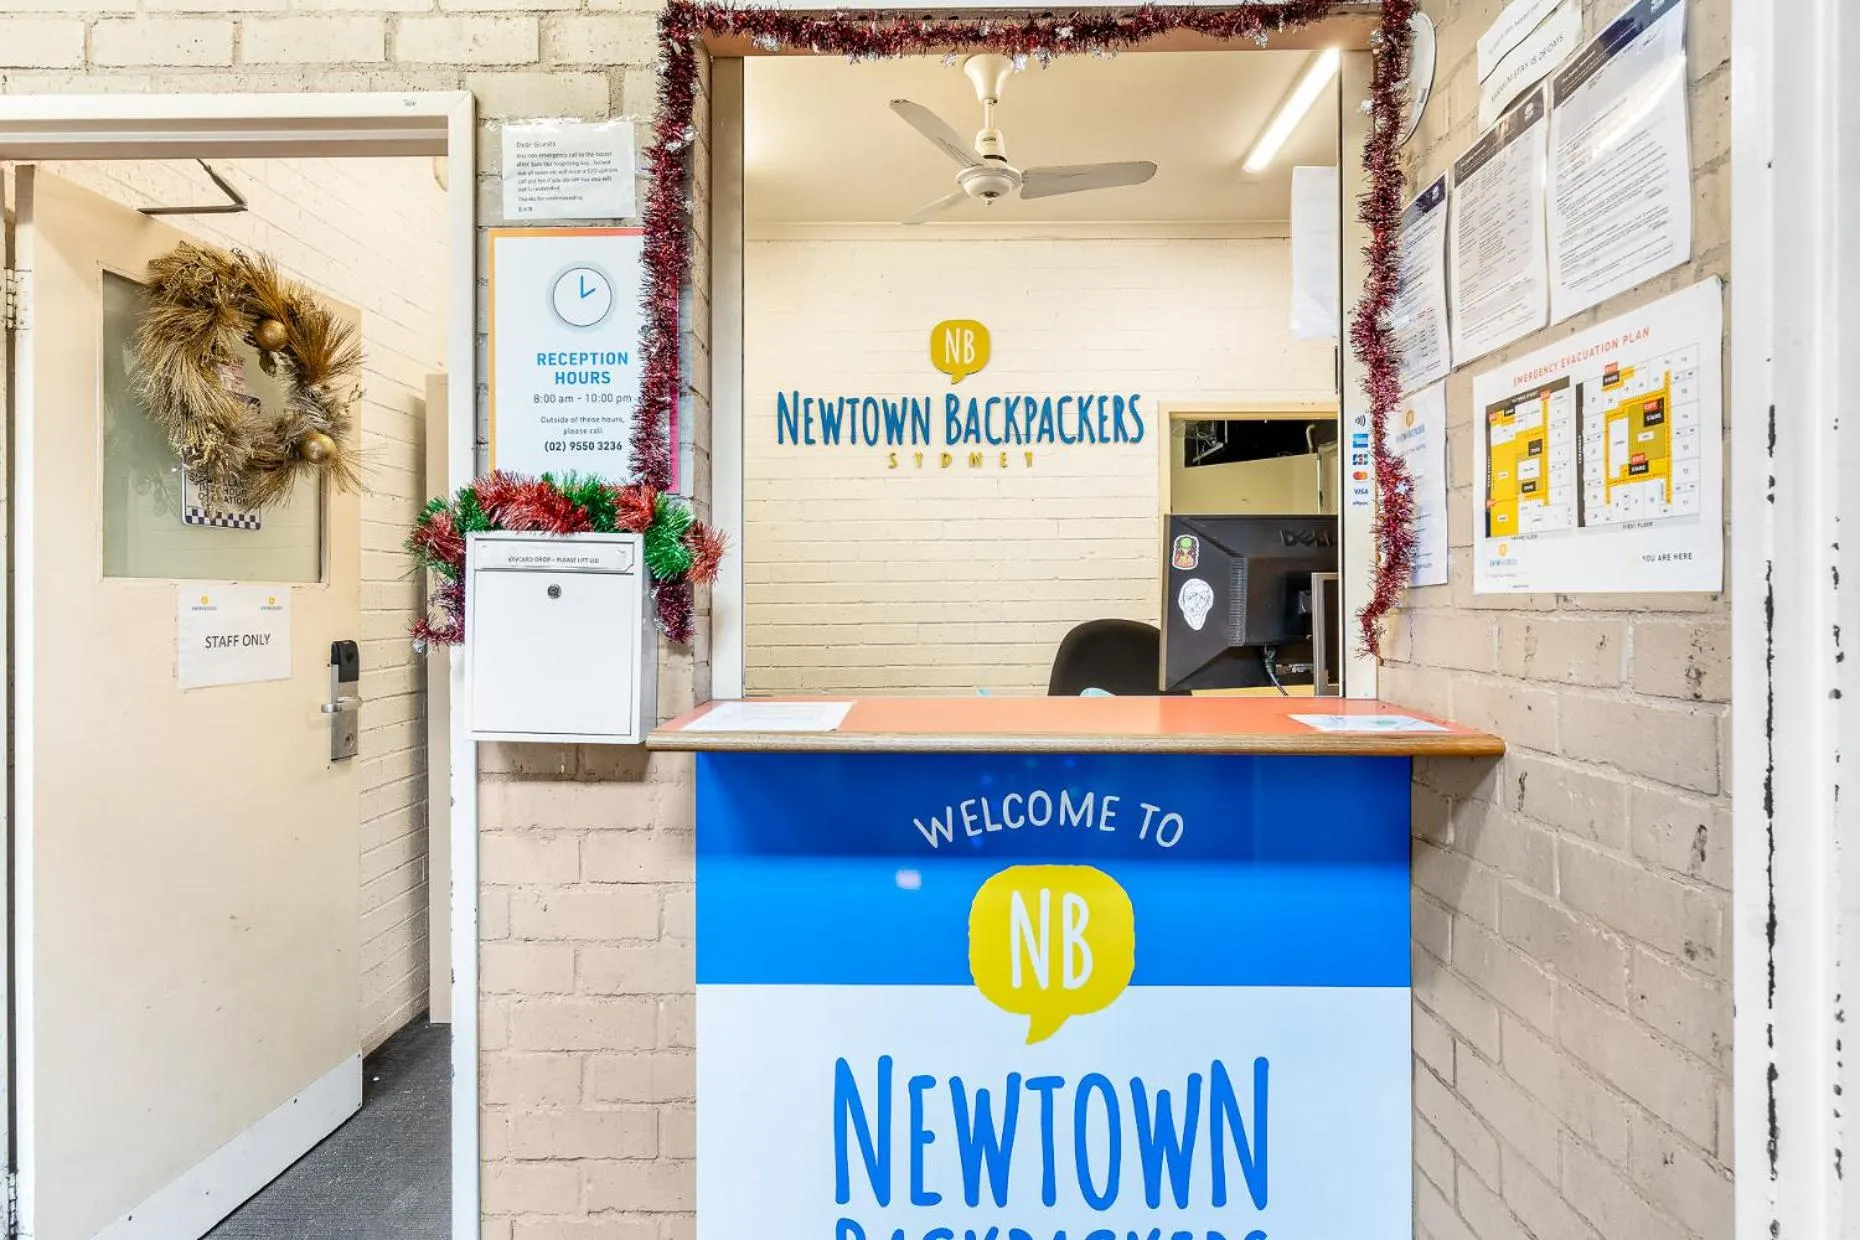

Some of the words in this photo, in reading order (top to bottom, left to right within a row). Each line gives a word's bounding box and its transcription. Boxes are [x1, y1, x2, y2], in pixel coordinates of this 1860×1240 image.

[945, 328, 976, 365] NB
[537, 353, 629, 366] RECEPTION
[1513, 363, 1559, 387] EMERGENCY
[1560, 338, 1619, 368] EVACUATION
[1622, 326, 1651, 346] PLAN
[555, 371, 611, 384] HOURS
[533, 394, 556, 404] 8:00
[558, 396, 574, 404] am
[585, 394, 614, 403] 10:00
[615, 396, 632, 406] pm
[540, 416, 569, 424] Outside
[570, 415, 579, 423] of
[579, 415, 600, 424] these
[777, 390, 931, 447] NEWTOWN
[945, 392, 1145, 447] BACKPACKERS
[563, 427, 588, 436] please
[544, 441, 567, 453] (02)
[569, 440, 595, 451] 9550
[597, 440, 623, 451] 3236
[888, 451, 1035, 469] SYDNEY
[1657, 553, 1671, 561] ARE
[1673, 552, 1693, 560] HERE
[205, 635, 240, 649] STAFF
[242, 632, 271, 647] ONLY
[913, 790, 1121, 848] WELCOME
[1139, 802, 1184, 848] TO
[1010, 888, 1094, 991] NB
[833, 1055, 1269, 1211] NEWTOWN
